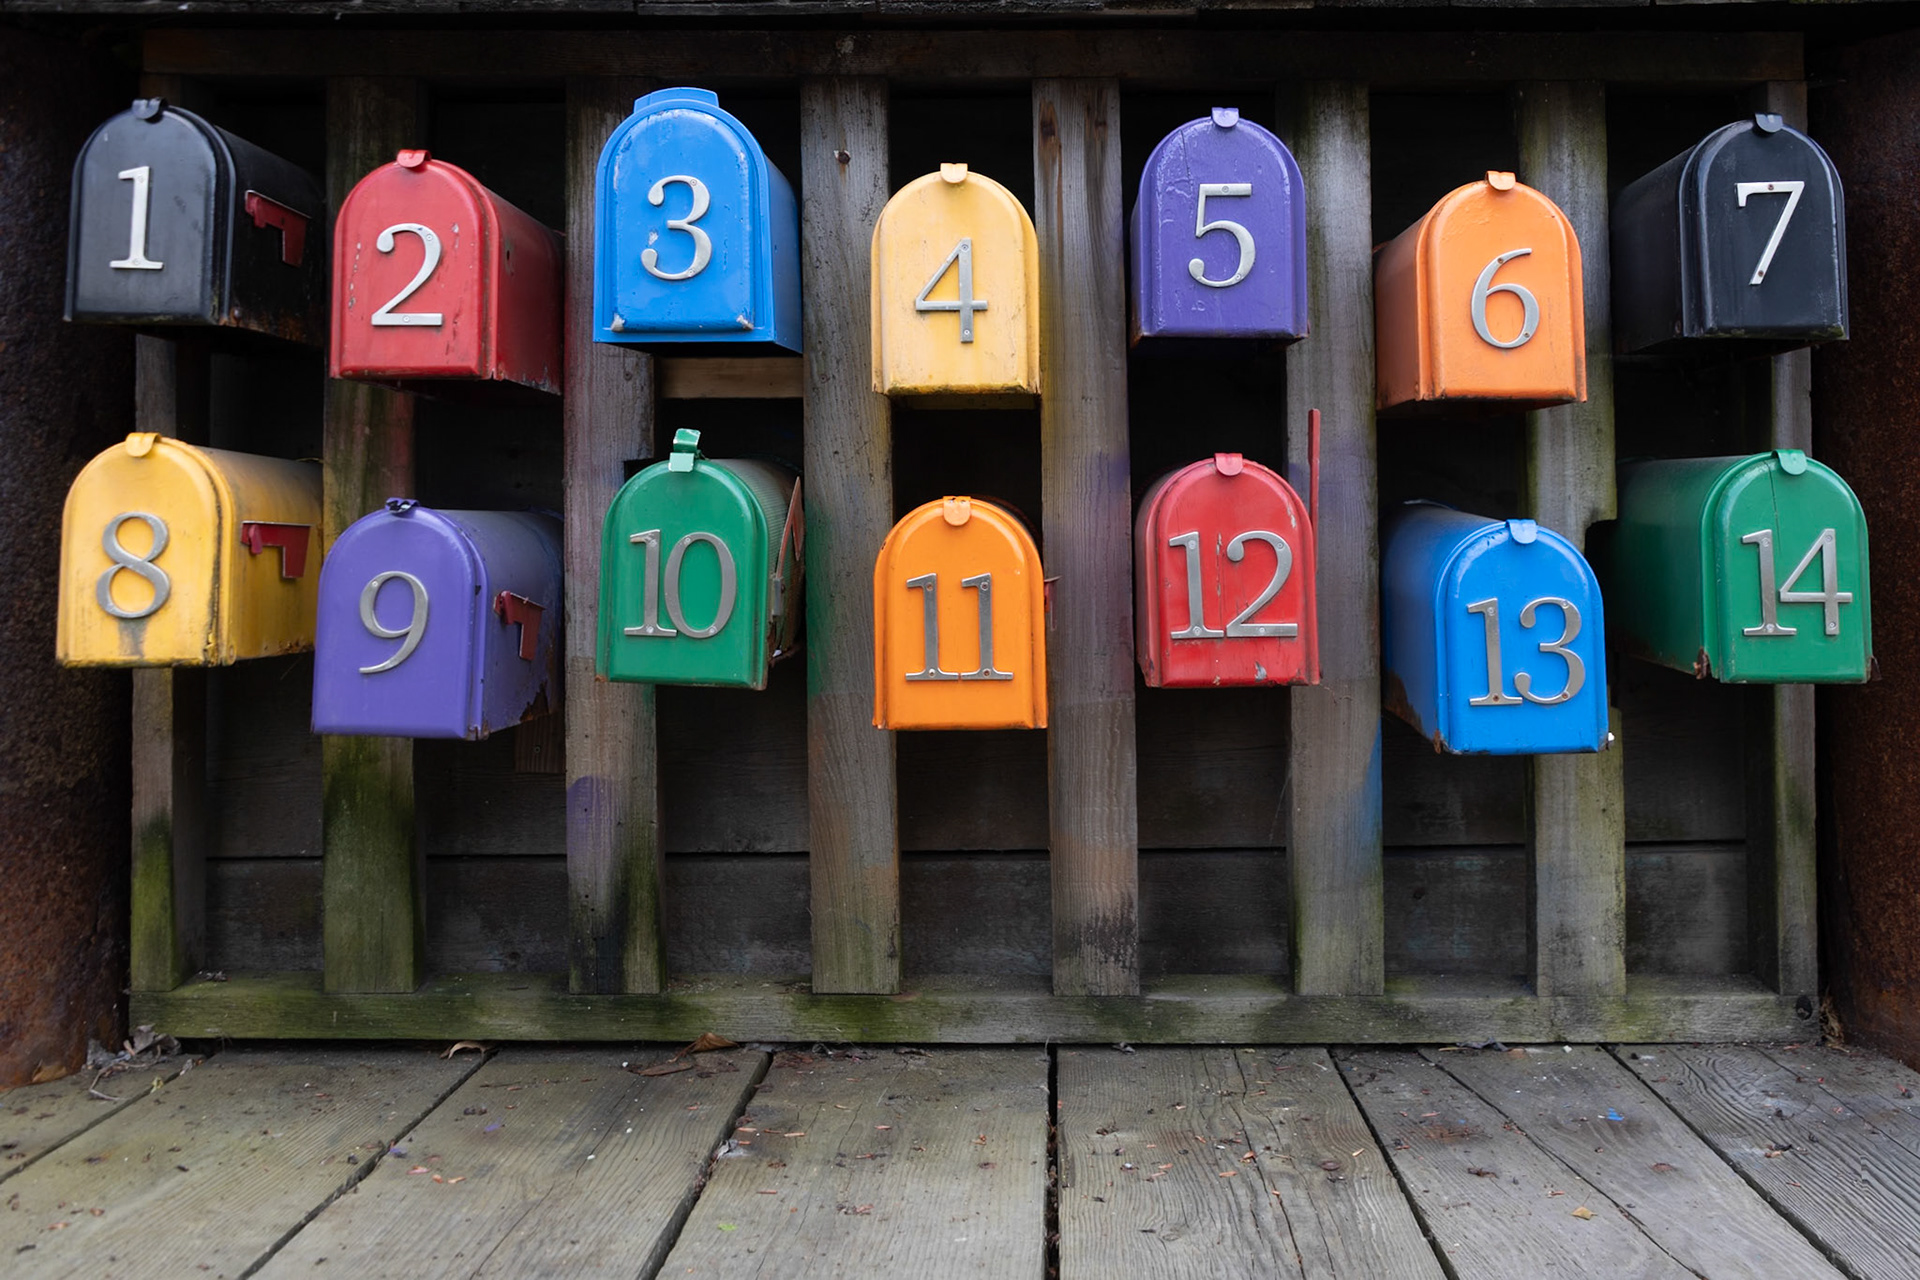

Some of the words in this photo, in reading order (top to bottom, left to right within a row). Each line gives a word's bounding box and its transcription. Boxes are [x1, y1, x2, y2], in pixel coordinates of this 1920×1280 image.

[109, 165, 163, 270] 1
[640, 174, 713, 281] 3
[1188, 183, 1256, 288] 5
[1735, 180, 1805, 286] 7
[371, 222, 443, 326] 2
[915, 238, 988, 343] 4
[1470, 247, 1540, 349] 6
[97, 511, 171, 619] 8
[623, 529, 737, 638] 10
[1169, 530, 1298, 638] 12
[1741, 528, 1853, 637] 14
[359, 570, 429, 674] 9
[905, 572, 1014, 681] 11
[1467, 597, 1586, 706] 13
